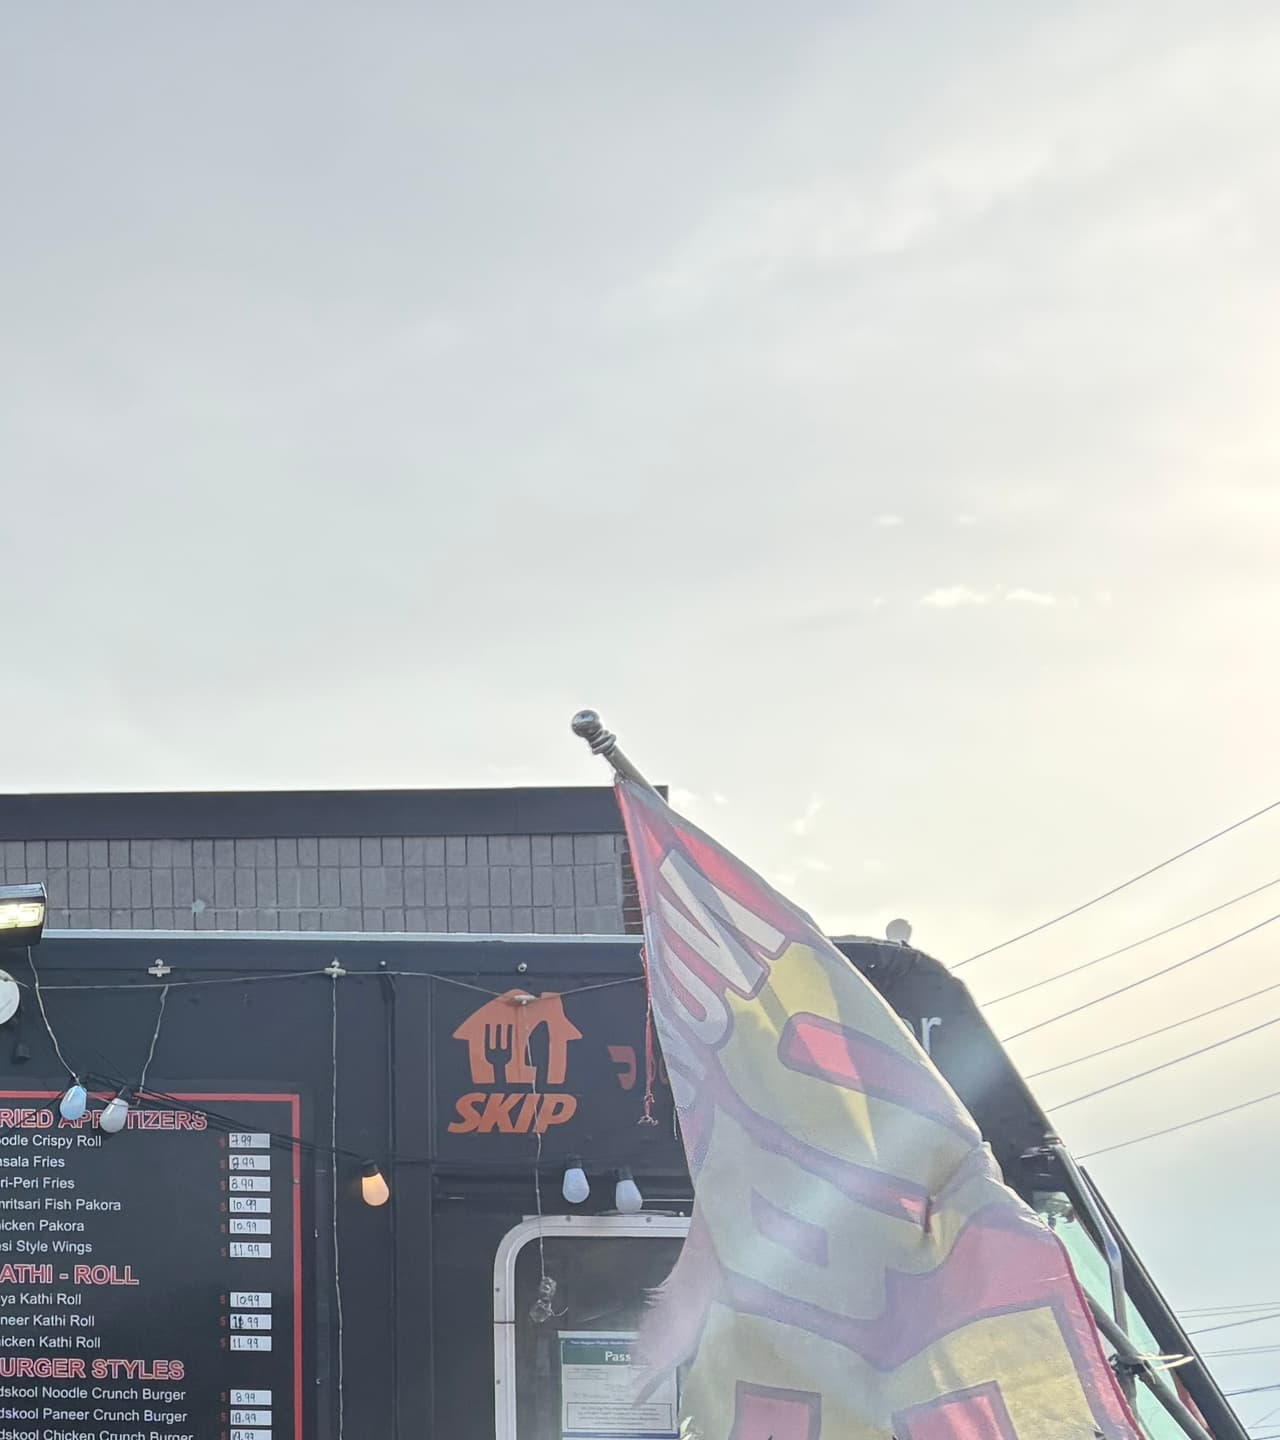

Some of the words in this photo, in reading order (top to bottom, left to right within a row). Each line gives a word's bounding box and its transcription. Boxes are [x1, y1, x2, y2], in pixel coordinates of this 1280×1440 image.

[447, 1093, 577, 1134] SKIP
[32, 1134, 73, 1150] Crispy
[76, 1134, 101, 1147] Roll
[32, 1155, 65, 1168] Fries
[41, 1176, 75, 1189] Fries
[44, 1198, 71, 1210] Fish
[75, 1198, 121, 1211] Pakora
[15, 1240, 48, 1256] Style
[51, 1240, 92, 1256] Wings
[73, 1265, 139, 1284] ROLL
[19, 1292, 52, 1305] Kathi
[56, 1292, 81, 1305] Roll
[605, 1351, 631, 1362] Pass
[91, 1358, 184, 1380] STYLES
[42, 1407, 89, 1420] Paneer
[92, 1408, 139, 1422] Crunch
[143, 1409, 187, 1425] Burger
